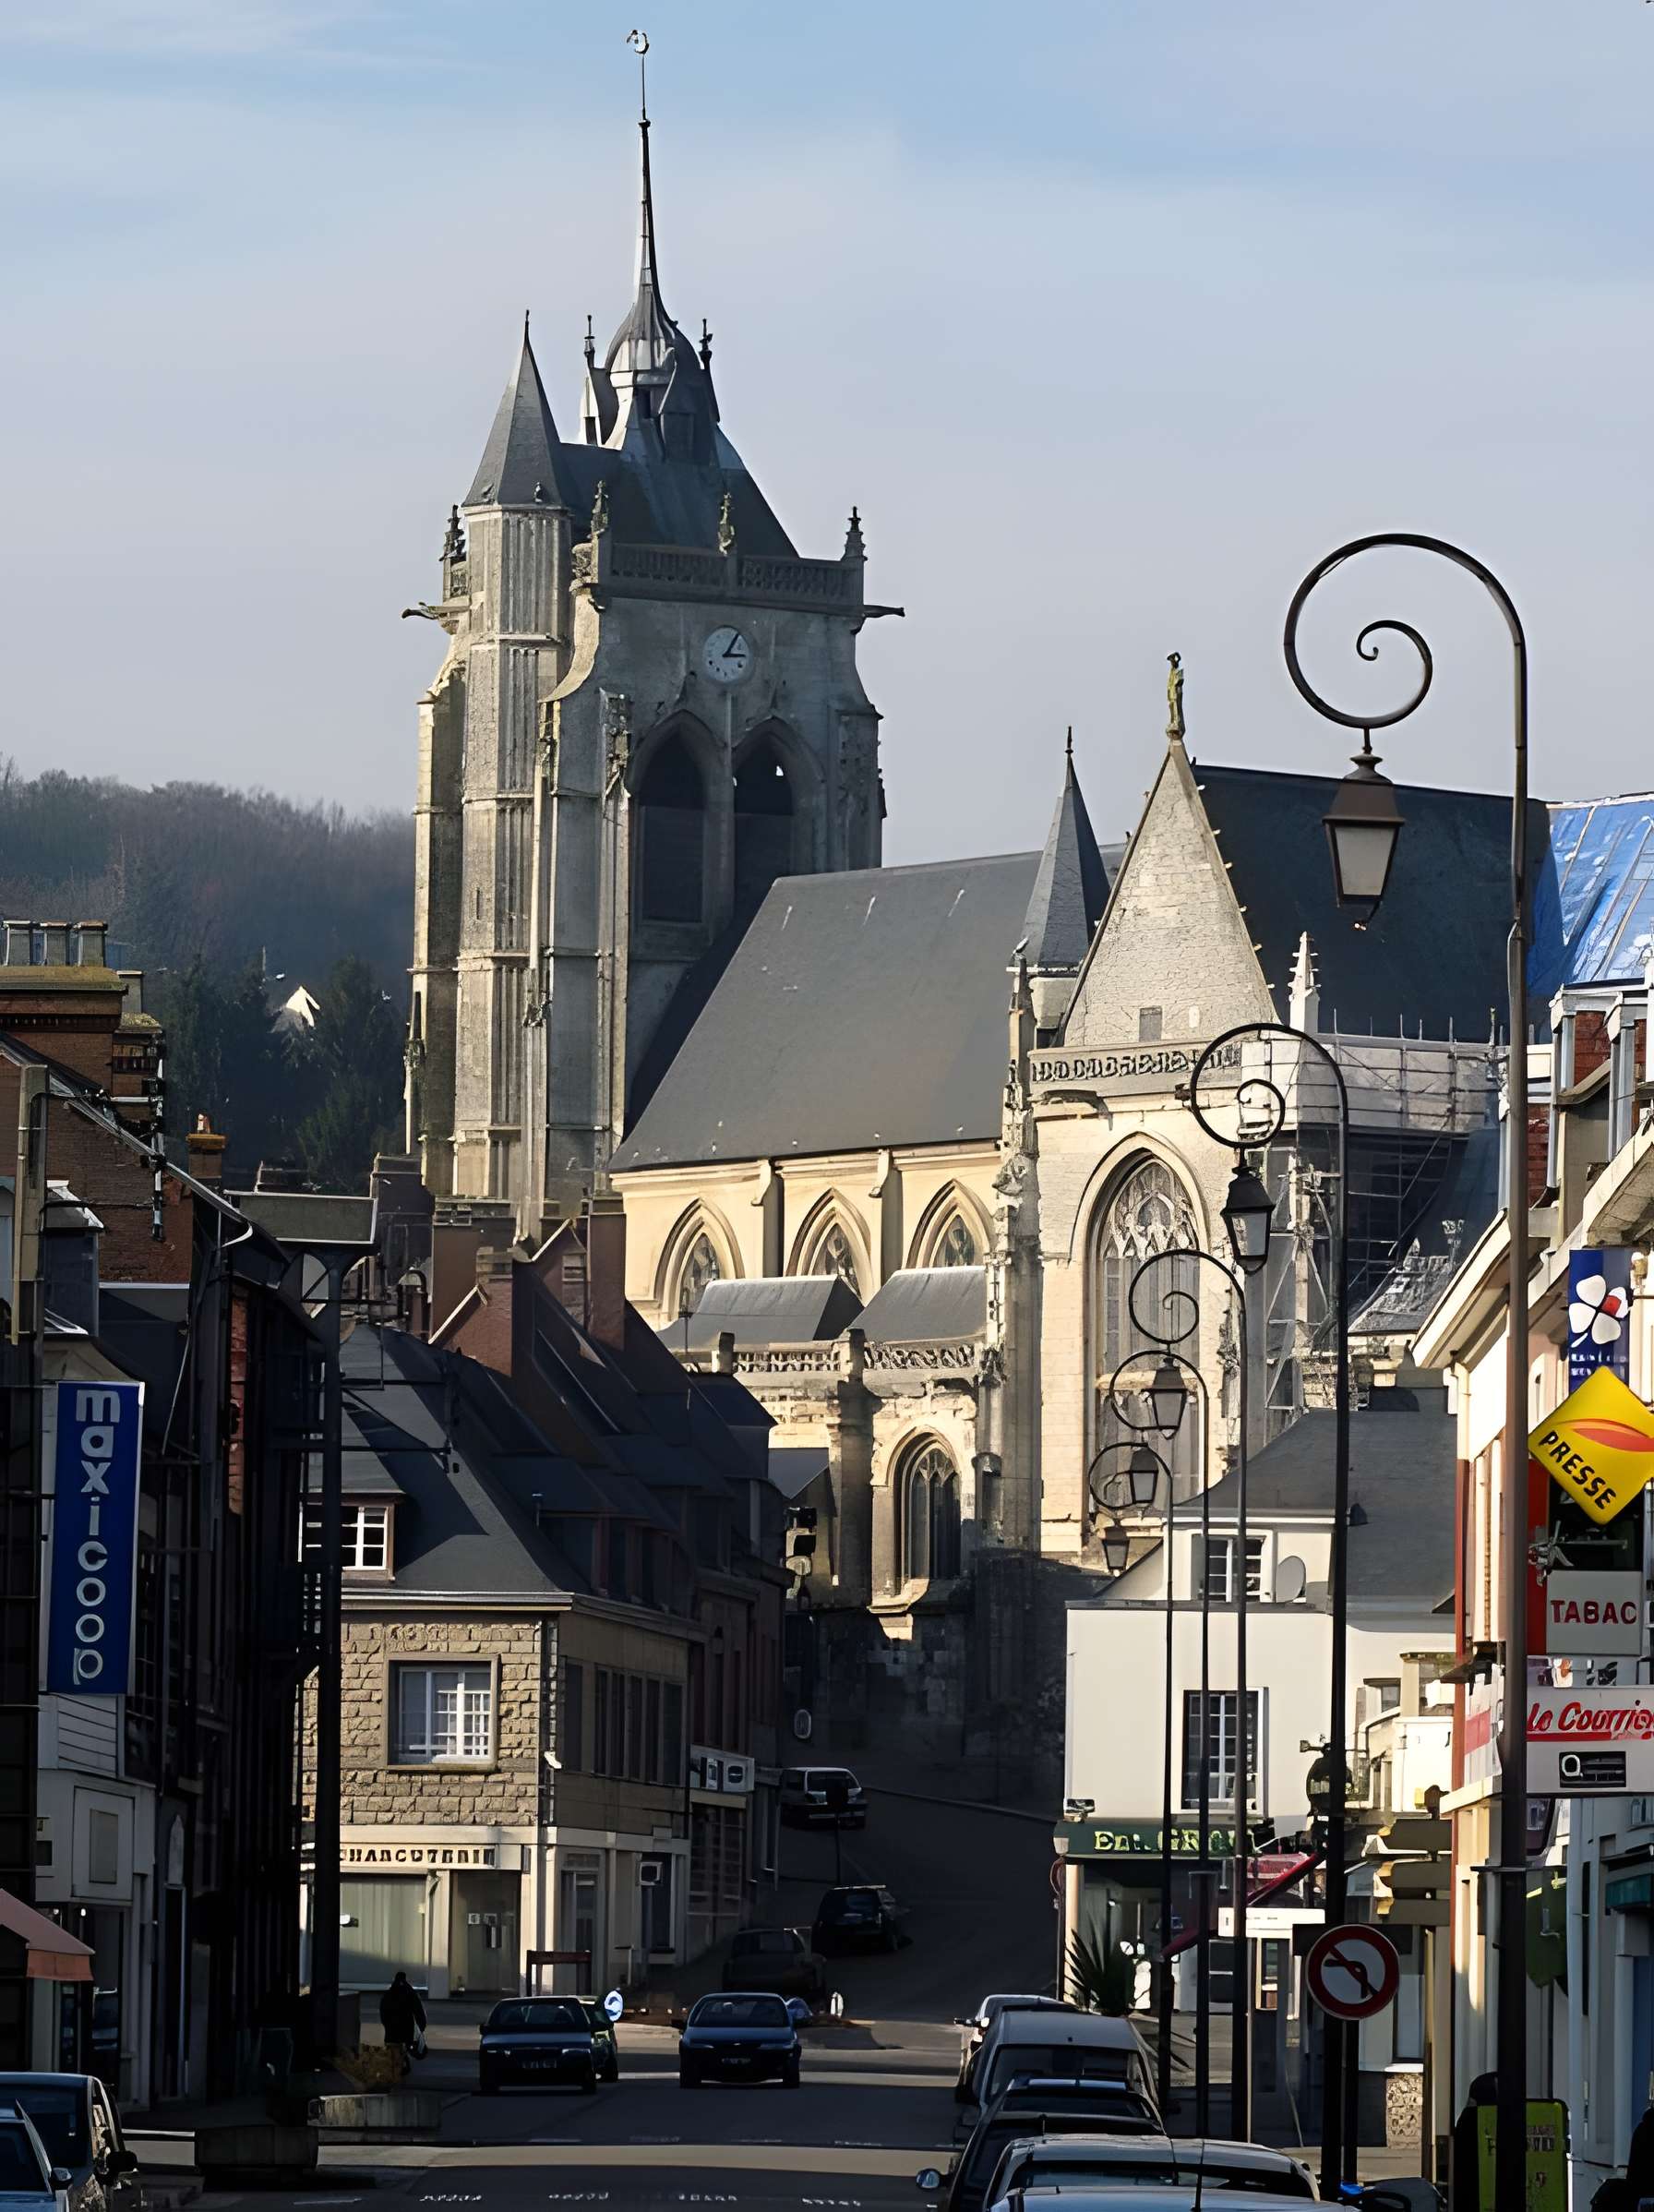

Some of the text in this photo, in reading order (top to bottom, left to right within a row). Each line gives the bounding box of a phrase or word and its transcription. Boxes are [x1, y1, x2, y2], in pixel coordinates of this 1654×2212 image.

[1539, 1430, 1616, 1510] PRESSE
[1551, 1600, 1637, 1624] TABAC
[1558, 1700, 1654, 1732] Courrie
